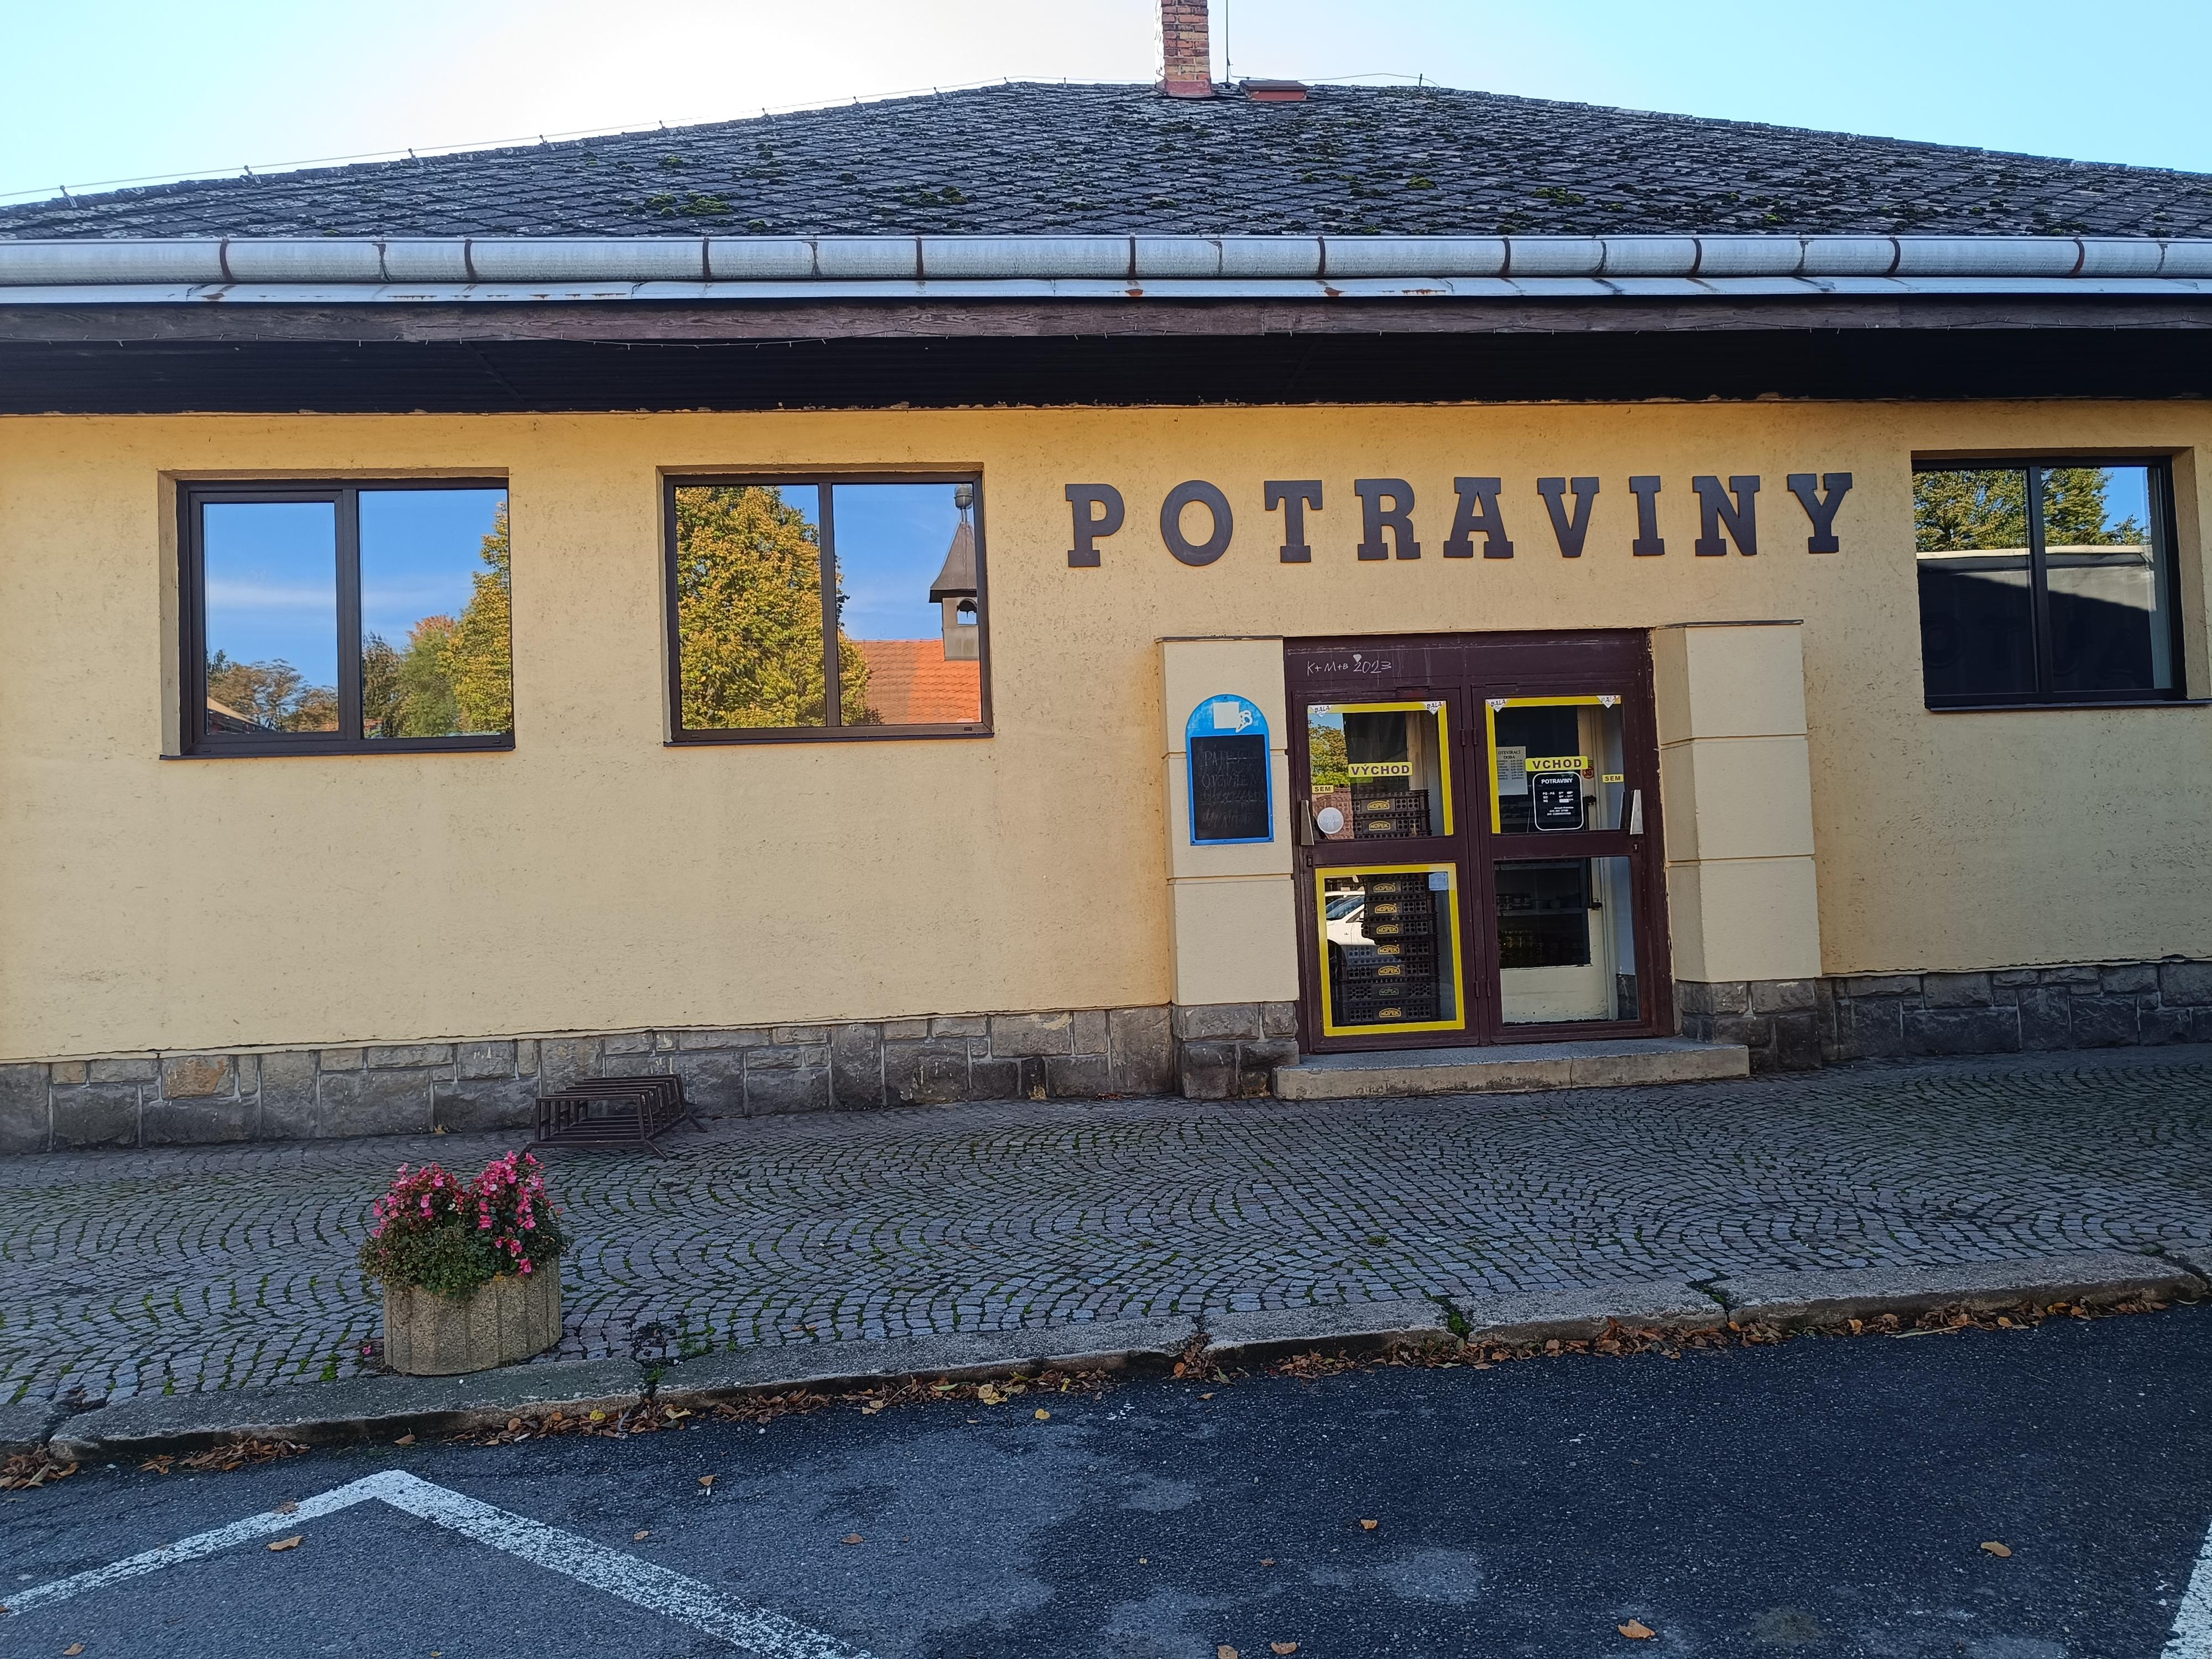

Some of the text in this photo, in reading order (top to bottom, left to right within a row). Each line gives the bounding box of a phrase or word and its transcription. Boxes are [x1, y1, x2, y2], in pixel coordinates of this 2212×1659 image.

[1065, 472, 1853, 567] POTRAVINY
[1353, 660, 1392, 674] 2023
[1351, 764, 1410, 775] VÝCHOD
[1532, 759, 1582, 769] VCHOD
